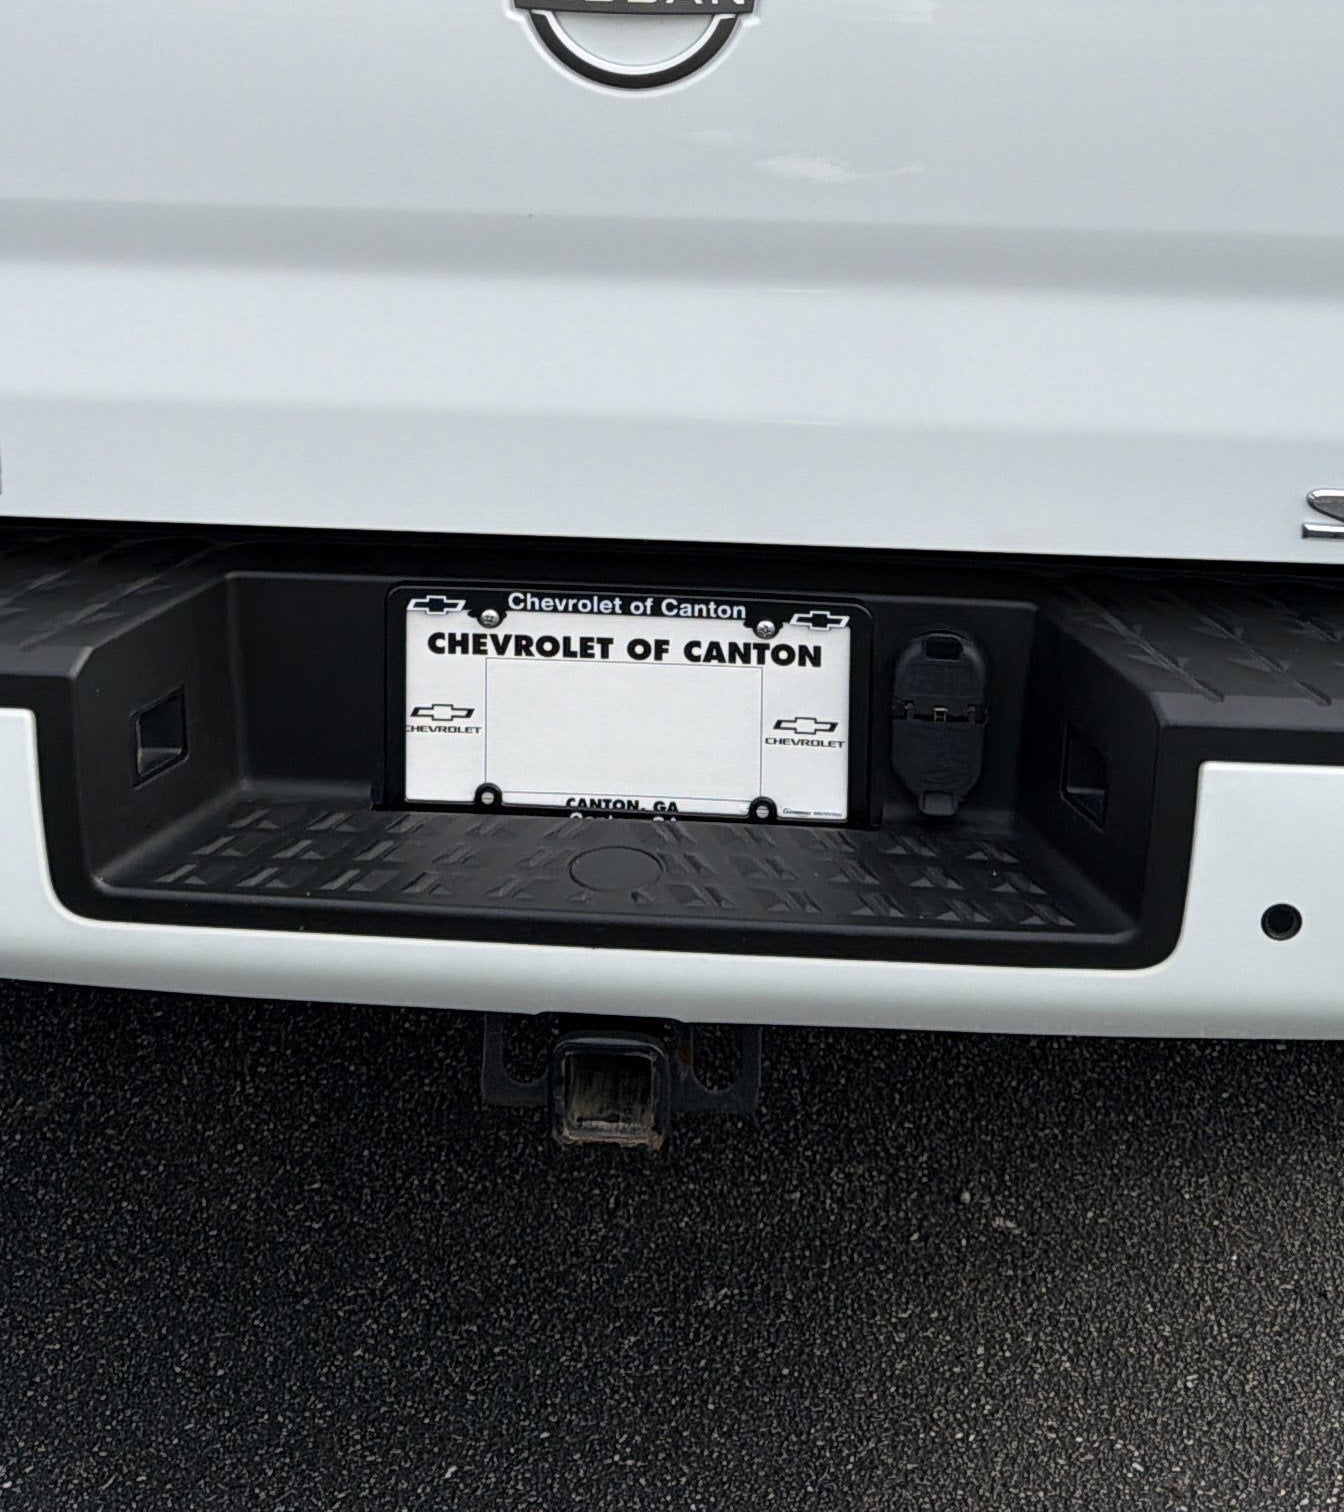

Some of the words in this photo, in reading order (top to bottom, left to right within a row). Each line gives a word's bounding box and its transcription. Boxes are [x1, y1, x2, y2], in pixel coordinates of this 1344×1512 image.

[507, 591, 623, 614] Chevrolet
[630, 597, 654, 615] of
[661, 598, 747, 619] Canton
[427, 631, 615, 660] CHEVROLET
[626, 637, 671, 662] OF
[683, 640, 823, 668] CANTON
[765, 737, 845, 749] CHEVROLET
[653, 800, 679, 813] GA
